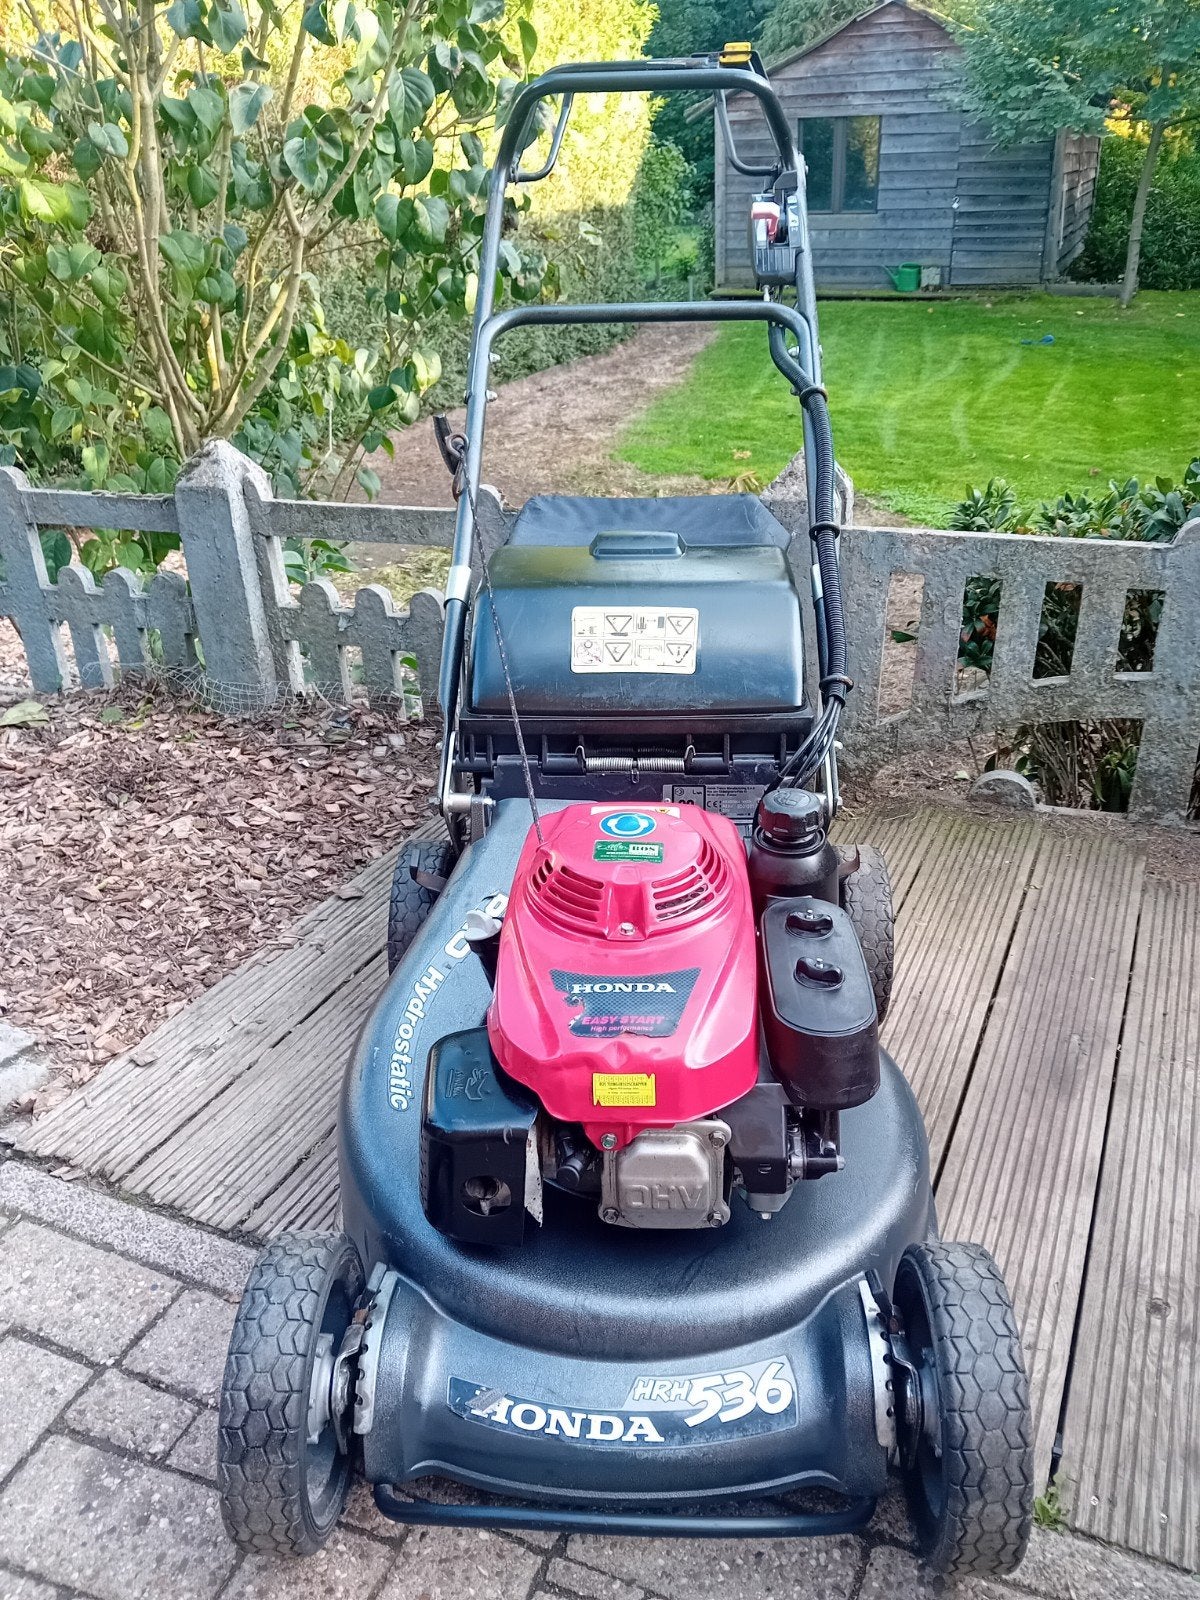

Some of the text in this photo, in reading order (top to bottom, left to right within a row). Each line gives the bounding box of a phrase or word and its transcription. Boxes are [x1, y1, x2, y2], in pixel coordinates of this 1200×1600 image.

[570, 982, 677, 994] HONDA
[581, 1015, 666, 1025] EASY START
[590, 1025, 654, 1033] High performance
[389, 965, 445, 1112] Hydrostatic
[683, 1361, 794, 1428] 536
[470, 1386, 665, 1443] HONDA
